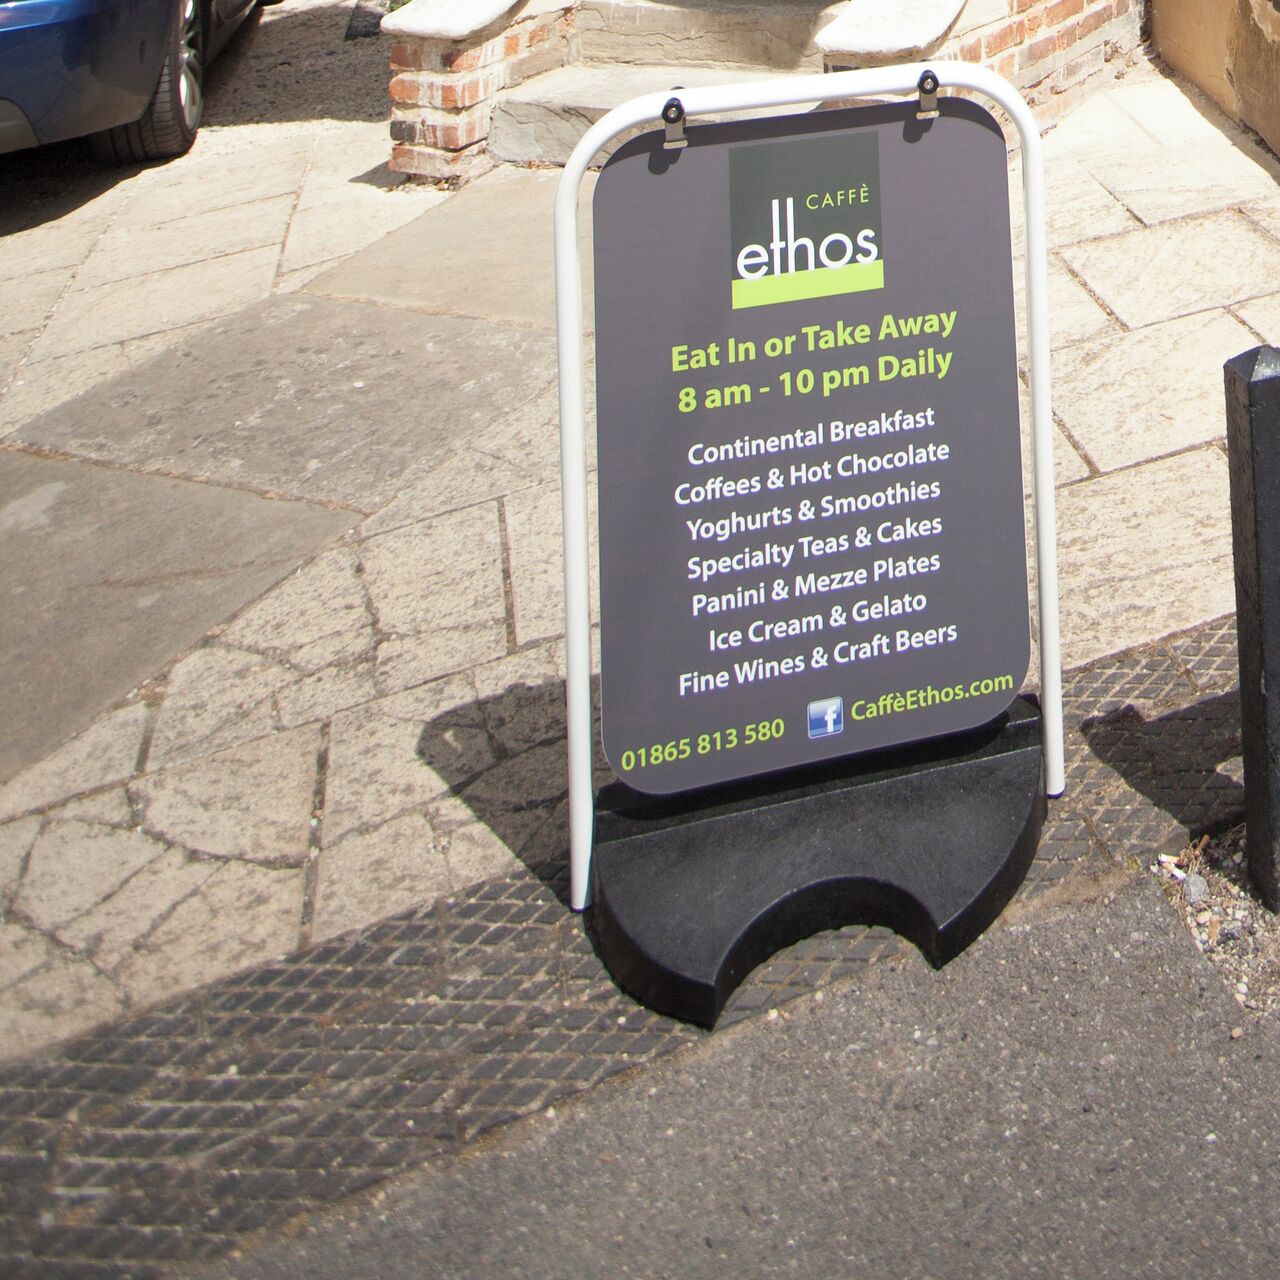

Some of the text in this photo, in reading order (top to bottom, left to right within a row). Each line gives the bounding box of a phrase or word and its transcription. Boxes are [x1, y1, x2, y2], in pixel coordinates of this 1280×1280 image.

[806, 183, 870, 211] CAFFÈ
[736, 197, 879, 281] ethos
[671, 310, 957, 372] Eat In or Take Away
[678, 387, 697, 413] 8
[704, 382, 751, 409] am
[779, 368, 815, 397] 10
[822, 364, 870, 397] pm
[878, 347, 953, 380] Daily
[687, 407, 936, 466] Continental Breakfast
[674, 443, 951, 506] Coffees & Hot Chocolate
[686, 480, 941, 542] Yoghurts & Smoothies
[687, 517, 943, 582] Specialty Teas & Cakes
[692, 552, 941, 617] Panini & Mezze Plates
[709, 593, 927, 652] Ice Cream & Gelato
[679, 622, 958, 696] Fine Wines & Craft Beers
[850, 672, 1014, 722] CaffèEthos.com
[620, 718, 786, 772] 01865 813 580
